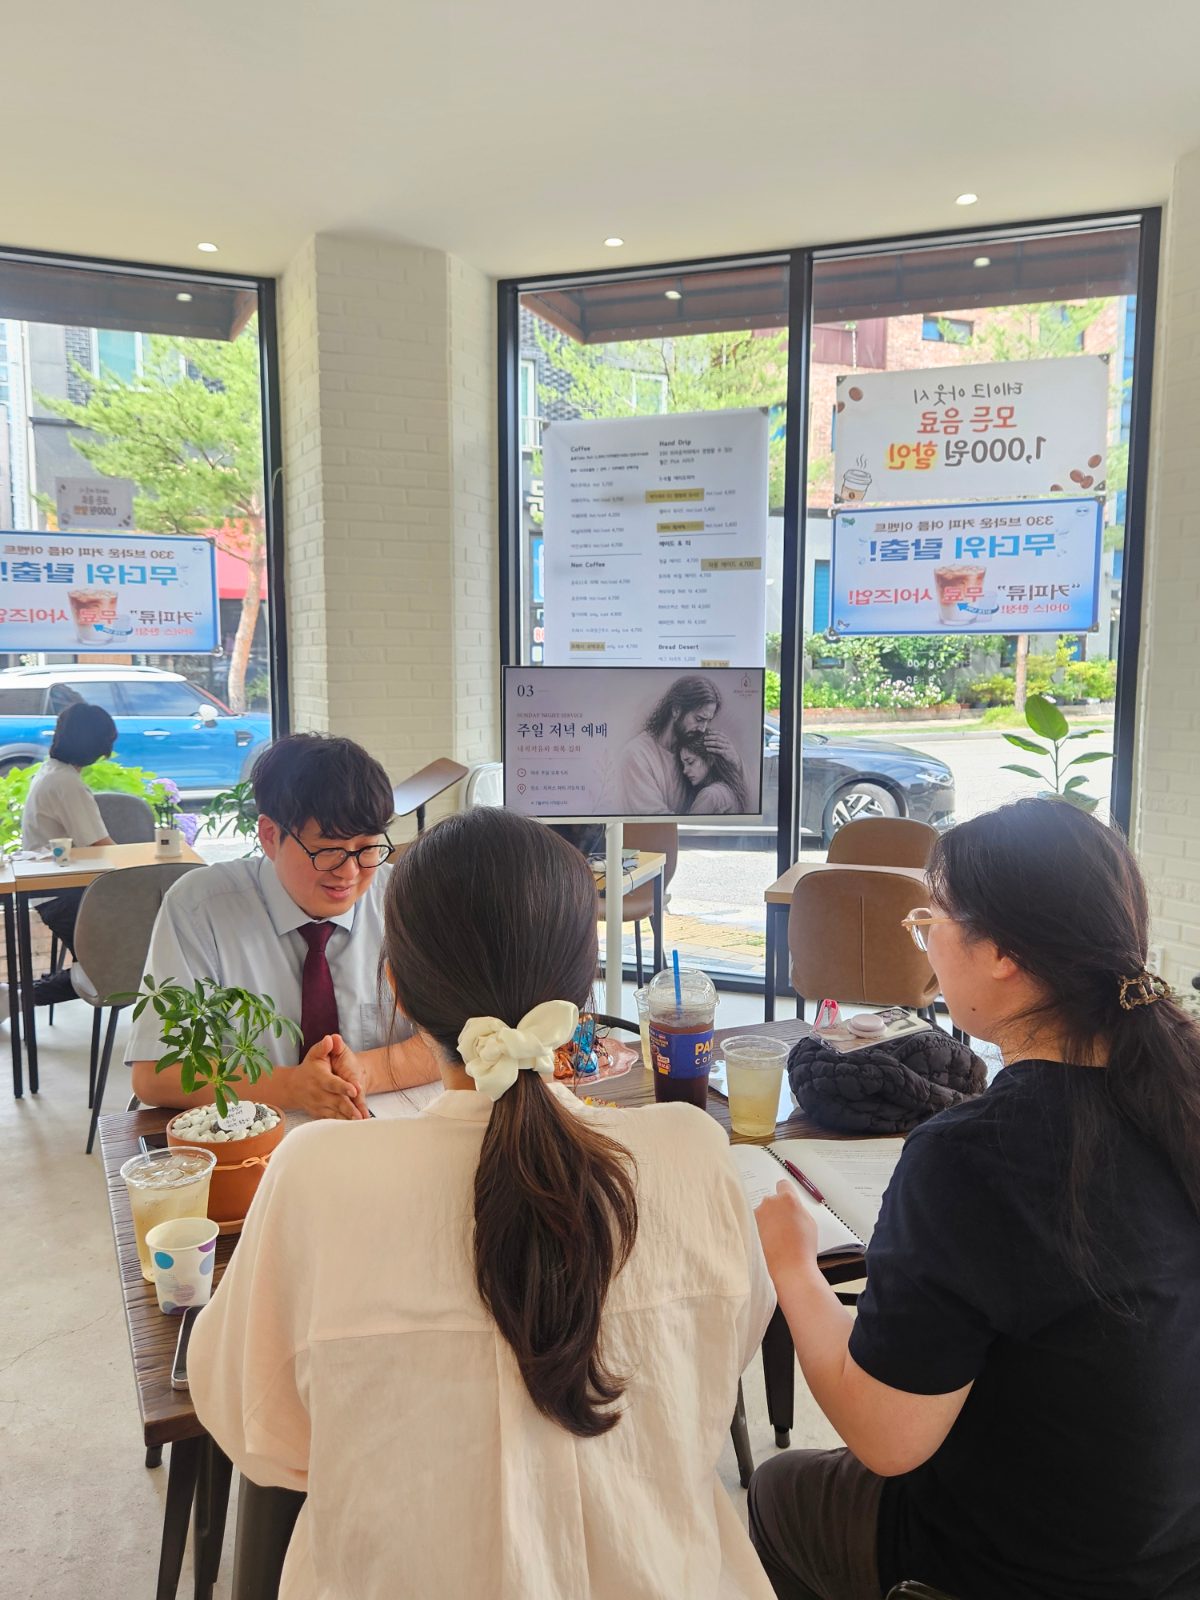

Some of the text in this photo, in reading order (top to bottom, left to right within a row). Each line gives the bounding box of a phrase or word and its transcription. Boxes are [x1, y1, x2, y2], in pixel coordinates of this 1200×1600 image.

[517, 685, 534, 697] 03
[517, 723, 607, 738] 주일 저녁 예배
